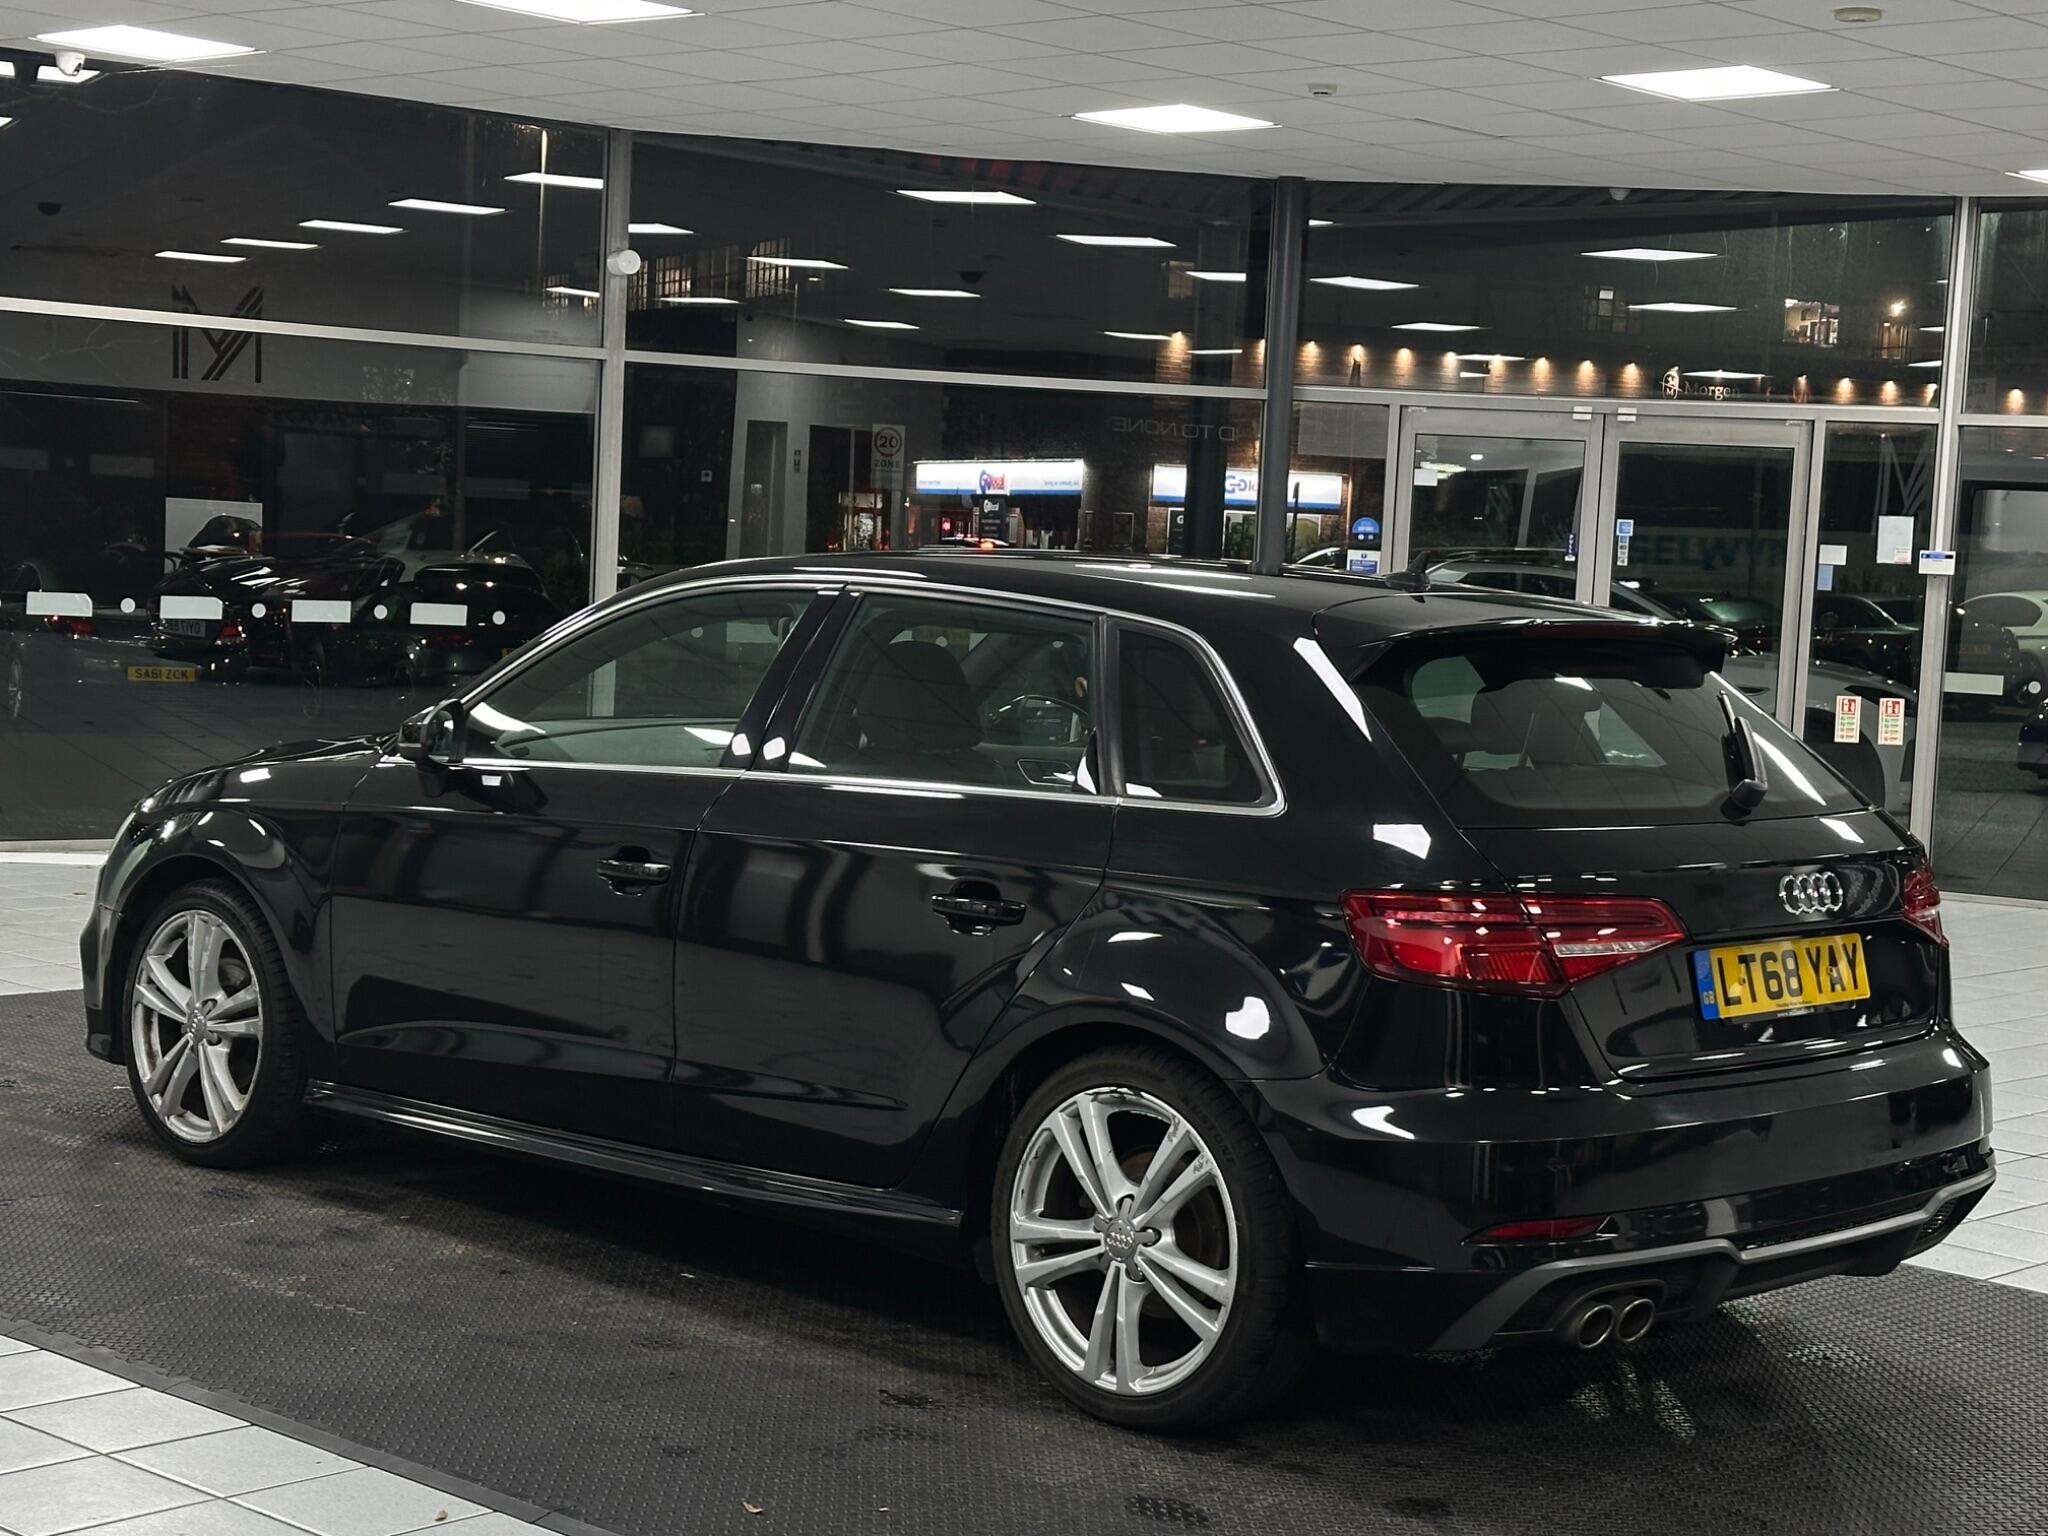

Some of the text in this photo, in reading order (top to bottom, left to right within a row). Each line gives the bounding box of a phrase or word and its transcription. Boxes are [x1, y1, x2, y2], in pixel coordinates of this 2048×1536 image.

[880, 435, 898, 448] 20
[874, 459, 900, 470] ZONE
[135, 668, 189, 681] SA61 ZCK
[1716, 942, 1860, 1007] LT68 YAY
[1703, 990, 1716, 1005] GB
